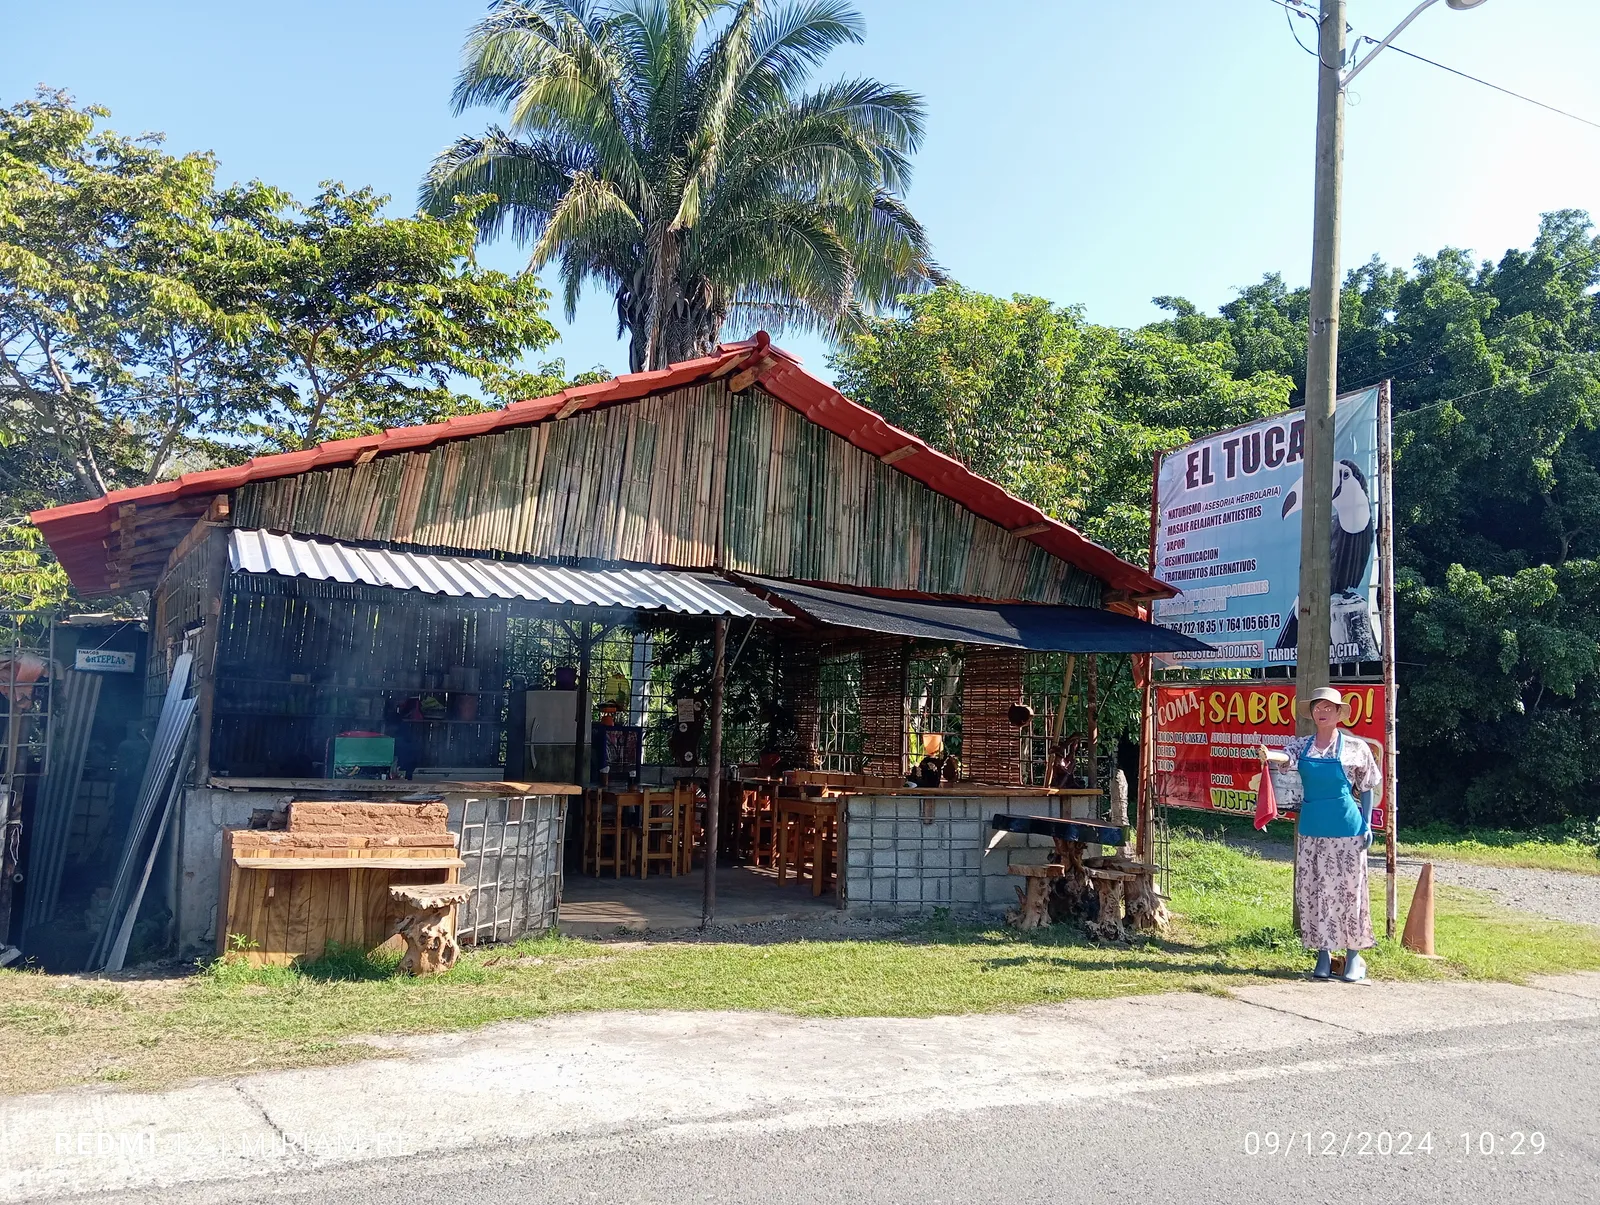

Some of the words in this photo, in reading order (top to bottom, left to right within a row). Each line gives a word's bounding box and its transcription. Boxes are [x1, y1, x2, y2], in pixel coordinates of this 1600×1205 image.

[1186, 446, 1214, 489] EL
[1168, 502, 1202, 520] NATURISMO
[1202, 496, 1235, 513] (ASESORIA
[1235, 486, 1282, 504] HERBOLARIA)
[1167, 524, 1189, 536] MASAJE
[1189, 514, 1222, 531] RELAJANTE
[1222, 505, 1262, 524] ANTIESTRES
[1167, 538, 1186, 552] VAPOR
[1165, 548, 1219, 567] DESINTOXICACION
[1164, 566, 1208, 582] TRATAMIENTOS
[1209, 559, 1256, 576] ALTERNATIVOS
[1238, 581, 1268, 596] VIERNES
[1184, 622, 1195, 634] 112
[1197, 621, 1205, 633] 18
[1205, 620, 1216, 632] 35
[1219, 619, 1224, 632] Y
[1227, 618, 1240, 631] 764
[1242, 617, 1257, 630] 105
[1258, 615, 1269, 629] 66
[1271, 614, 1280, 628] 73
[1217, 646, 1223, 658] A
[1224, 644, 1260, 658] 100MTS.
[1337, 643, 1360, 658] CITA
[1158, 692, 1200, 727] COMA
[1200, 688, 1375, 727] ¡SABRO!
[1184, 732, 1208, 744] CABEZA
[1232, 733, 1241, 744] DE
[1211, 746, 1228, 758] JUGO
[1229, 747, 1239, 758] DE
[1211, 774, 1234, 786] POZOL
